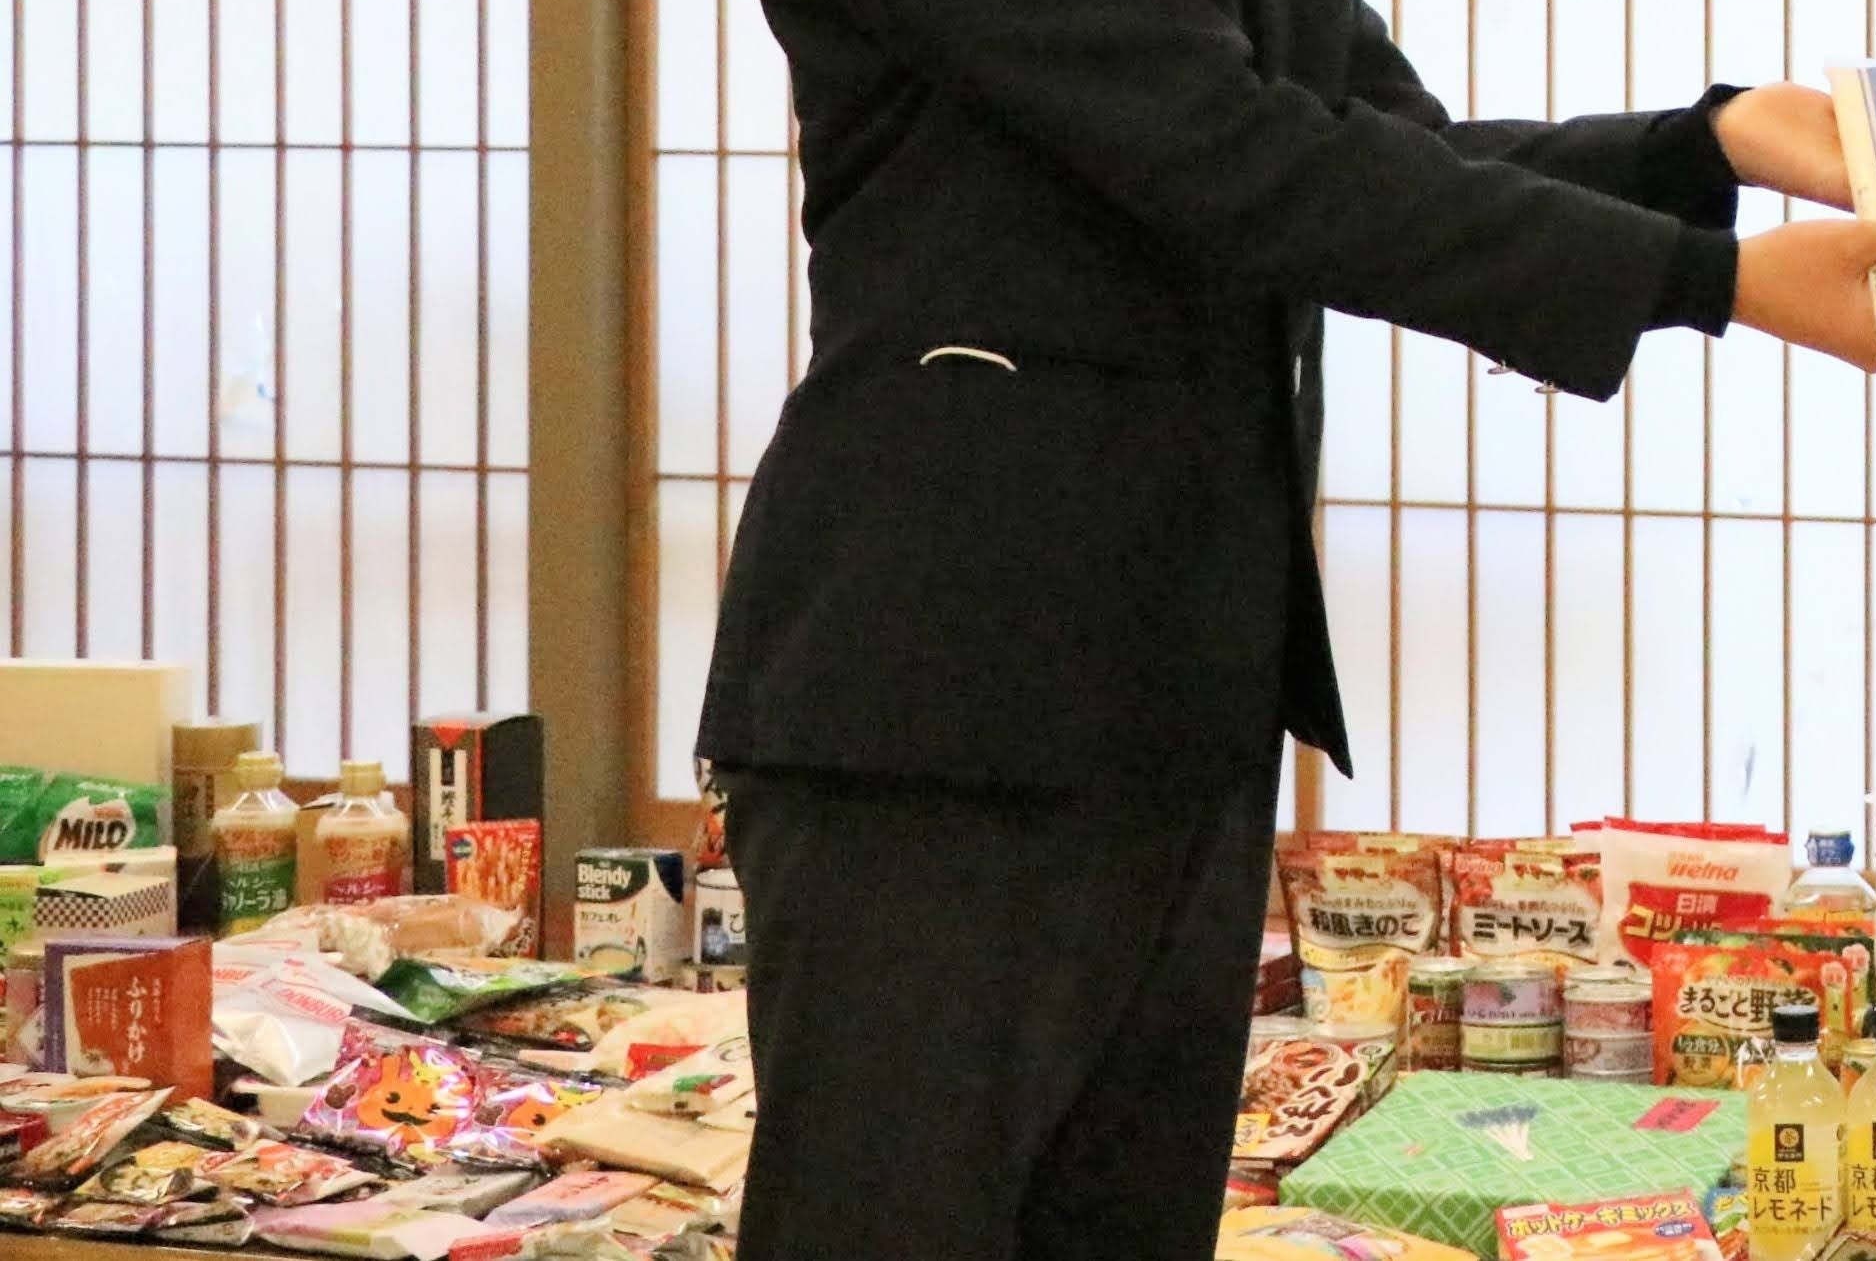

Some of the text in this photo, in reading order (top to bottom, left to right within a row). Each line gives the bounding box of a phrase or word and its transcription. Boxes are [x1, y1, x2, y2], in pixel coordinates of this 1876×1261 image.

[54, 818, 128, 851] MILO
[577, 863, 632, 888] Blendy
[577, 886, 611, 900] stick
[580, 910, 622, 924] カフェオレ
[1309, 908, 1420, 938] 和風きのこ
[1473, 913, 1592, 946] ミートソース
[127, 976, 148, 1063] ふりかけ
[1752, 1167, 1796, 1194] 京都
[1508, 1201, 1691, 1237] ホットケーキミックス
[1753, 1194, 1833, 1221] レモネード
